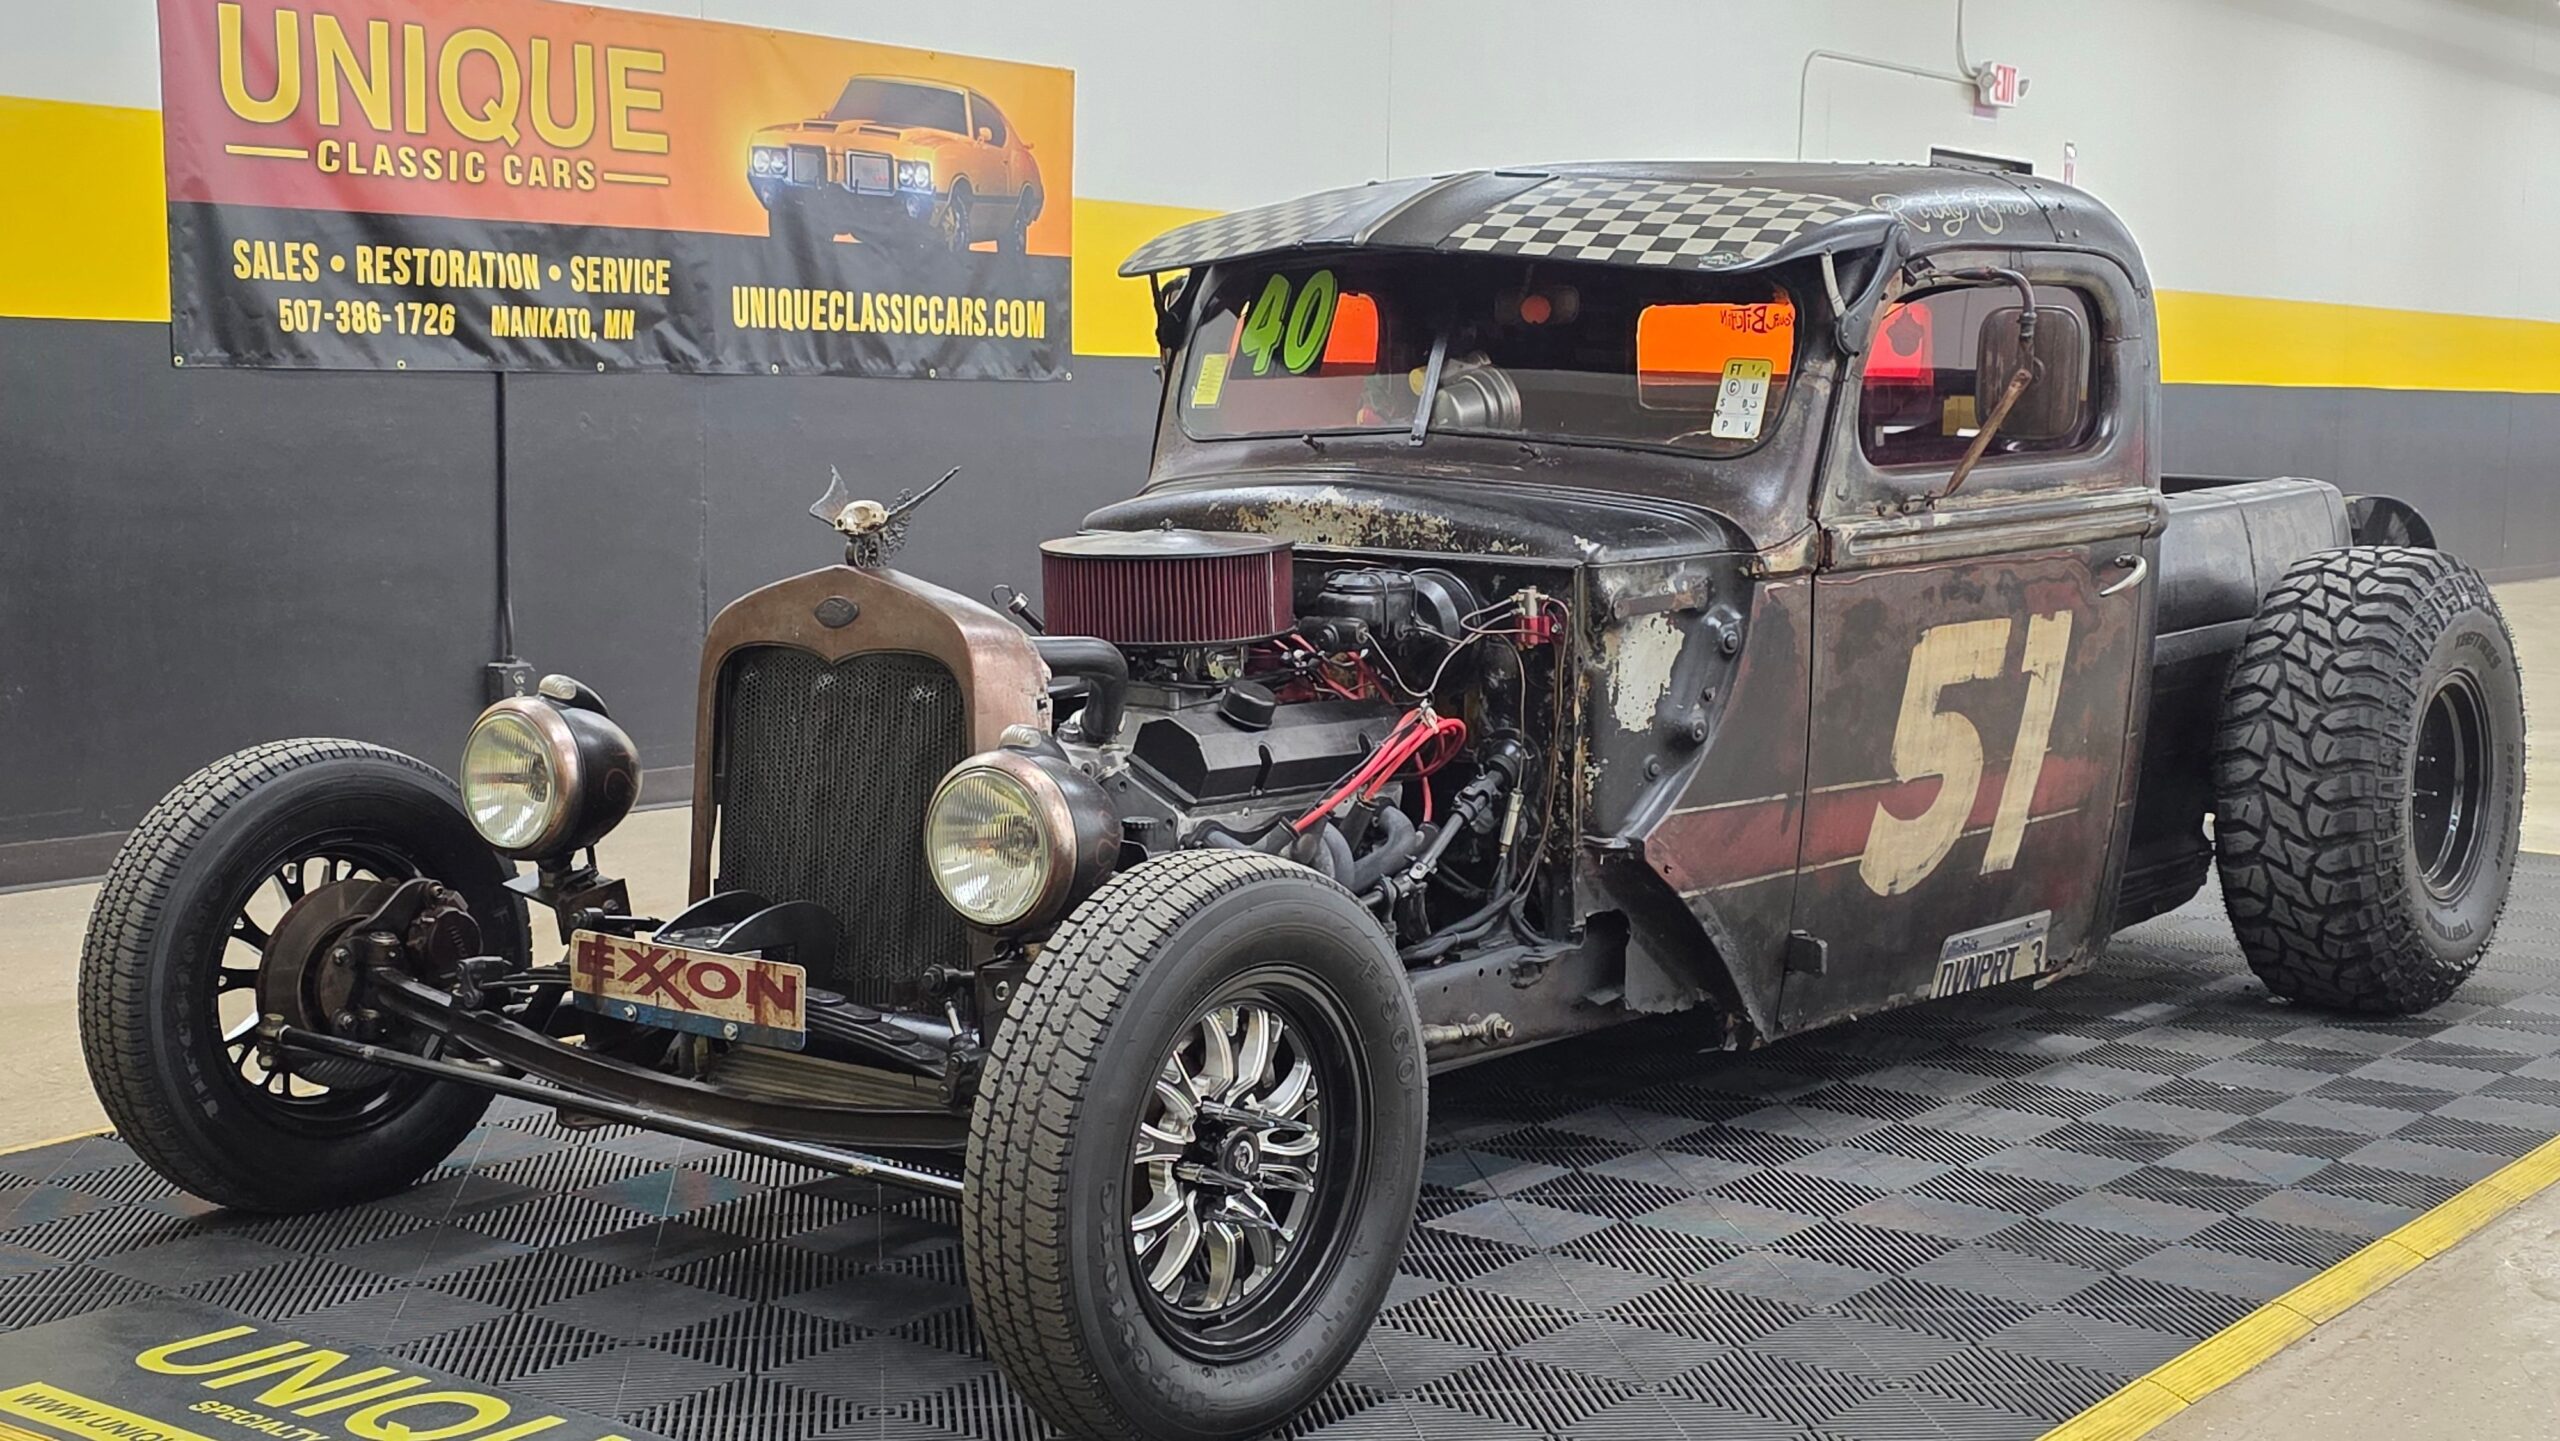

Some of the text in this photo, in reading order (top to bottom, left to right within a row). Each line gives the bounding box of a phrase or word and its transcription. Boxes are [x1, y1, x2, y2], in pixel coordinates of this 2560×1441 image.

[217, 1, 670, 154] UNIQUE
[317, 139, 597, 191] CLASSIC CARS
[232, 238, 672, 295] SALES RESTORATION SERVICE
[277, 298, 636, 343] 507-386-1726 MANKATO, MN
[731, 285, 1046, 340] UNIQUECLASSICCARS.COM
[1241, 269, 1338, 376] 40
[1751, 382, 1760, 395] U
[1721, 420, 1752, 434] P V
[1858, 609, 2073, 897] 51
[577, 938, 797, 1012] EXXON
